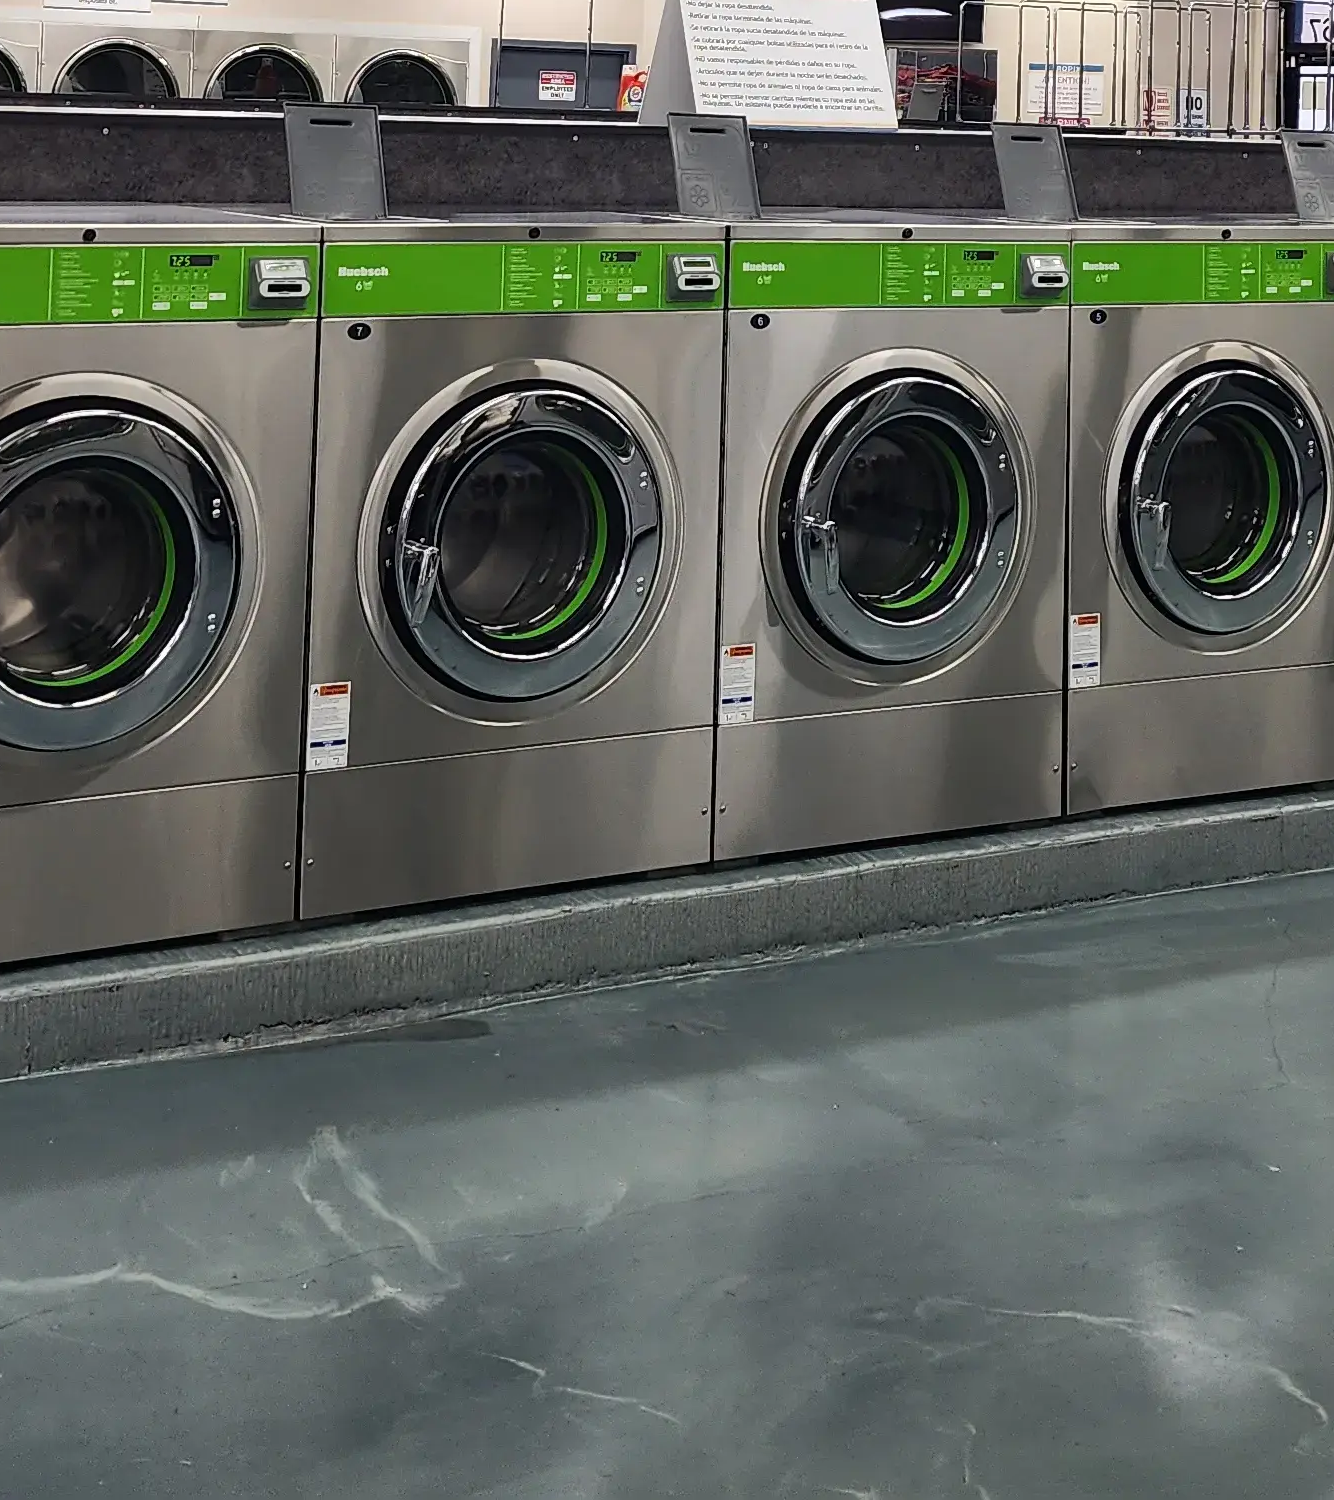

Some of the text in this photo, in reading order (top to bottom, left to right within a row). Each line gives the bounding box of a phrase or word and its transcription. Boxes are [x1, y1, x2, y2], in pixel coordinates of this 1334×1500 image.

[355, 281, 363, 291] 6
[757, 316, 764, 326] 6
[1096, 312, 1102, 321] 5
[356, 326, 364, 337] 7
